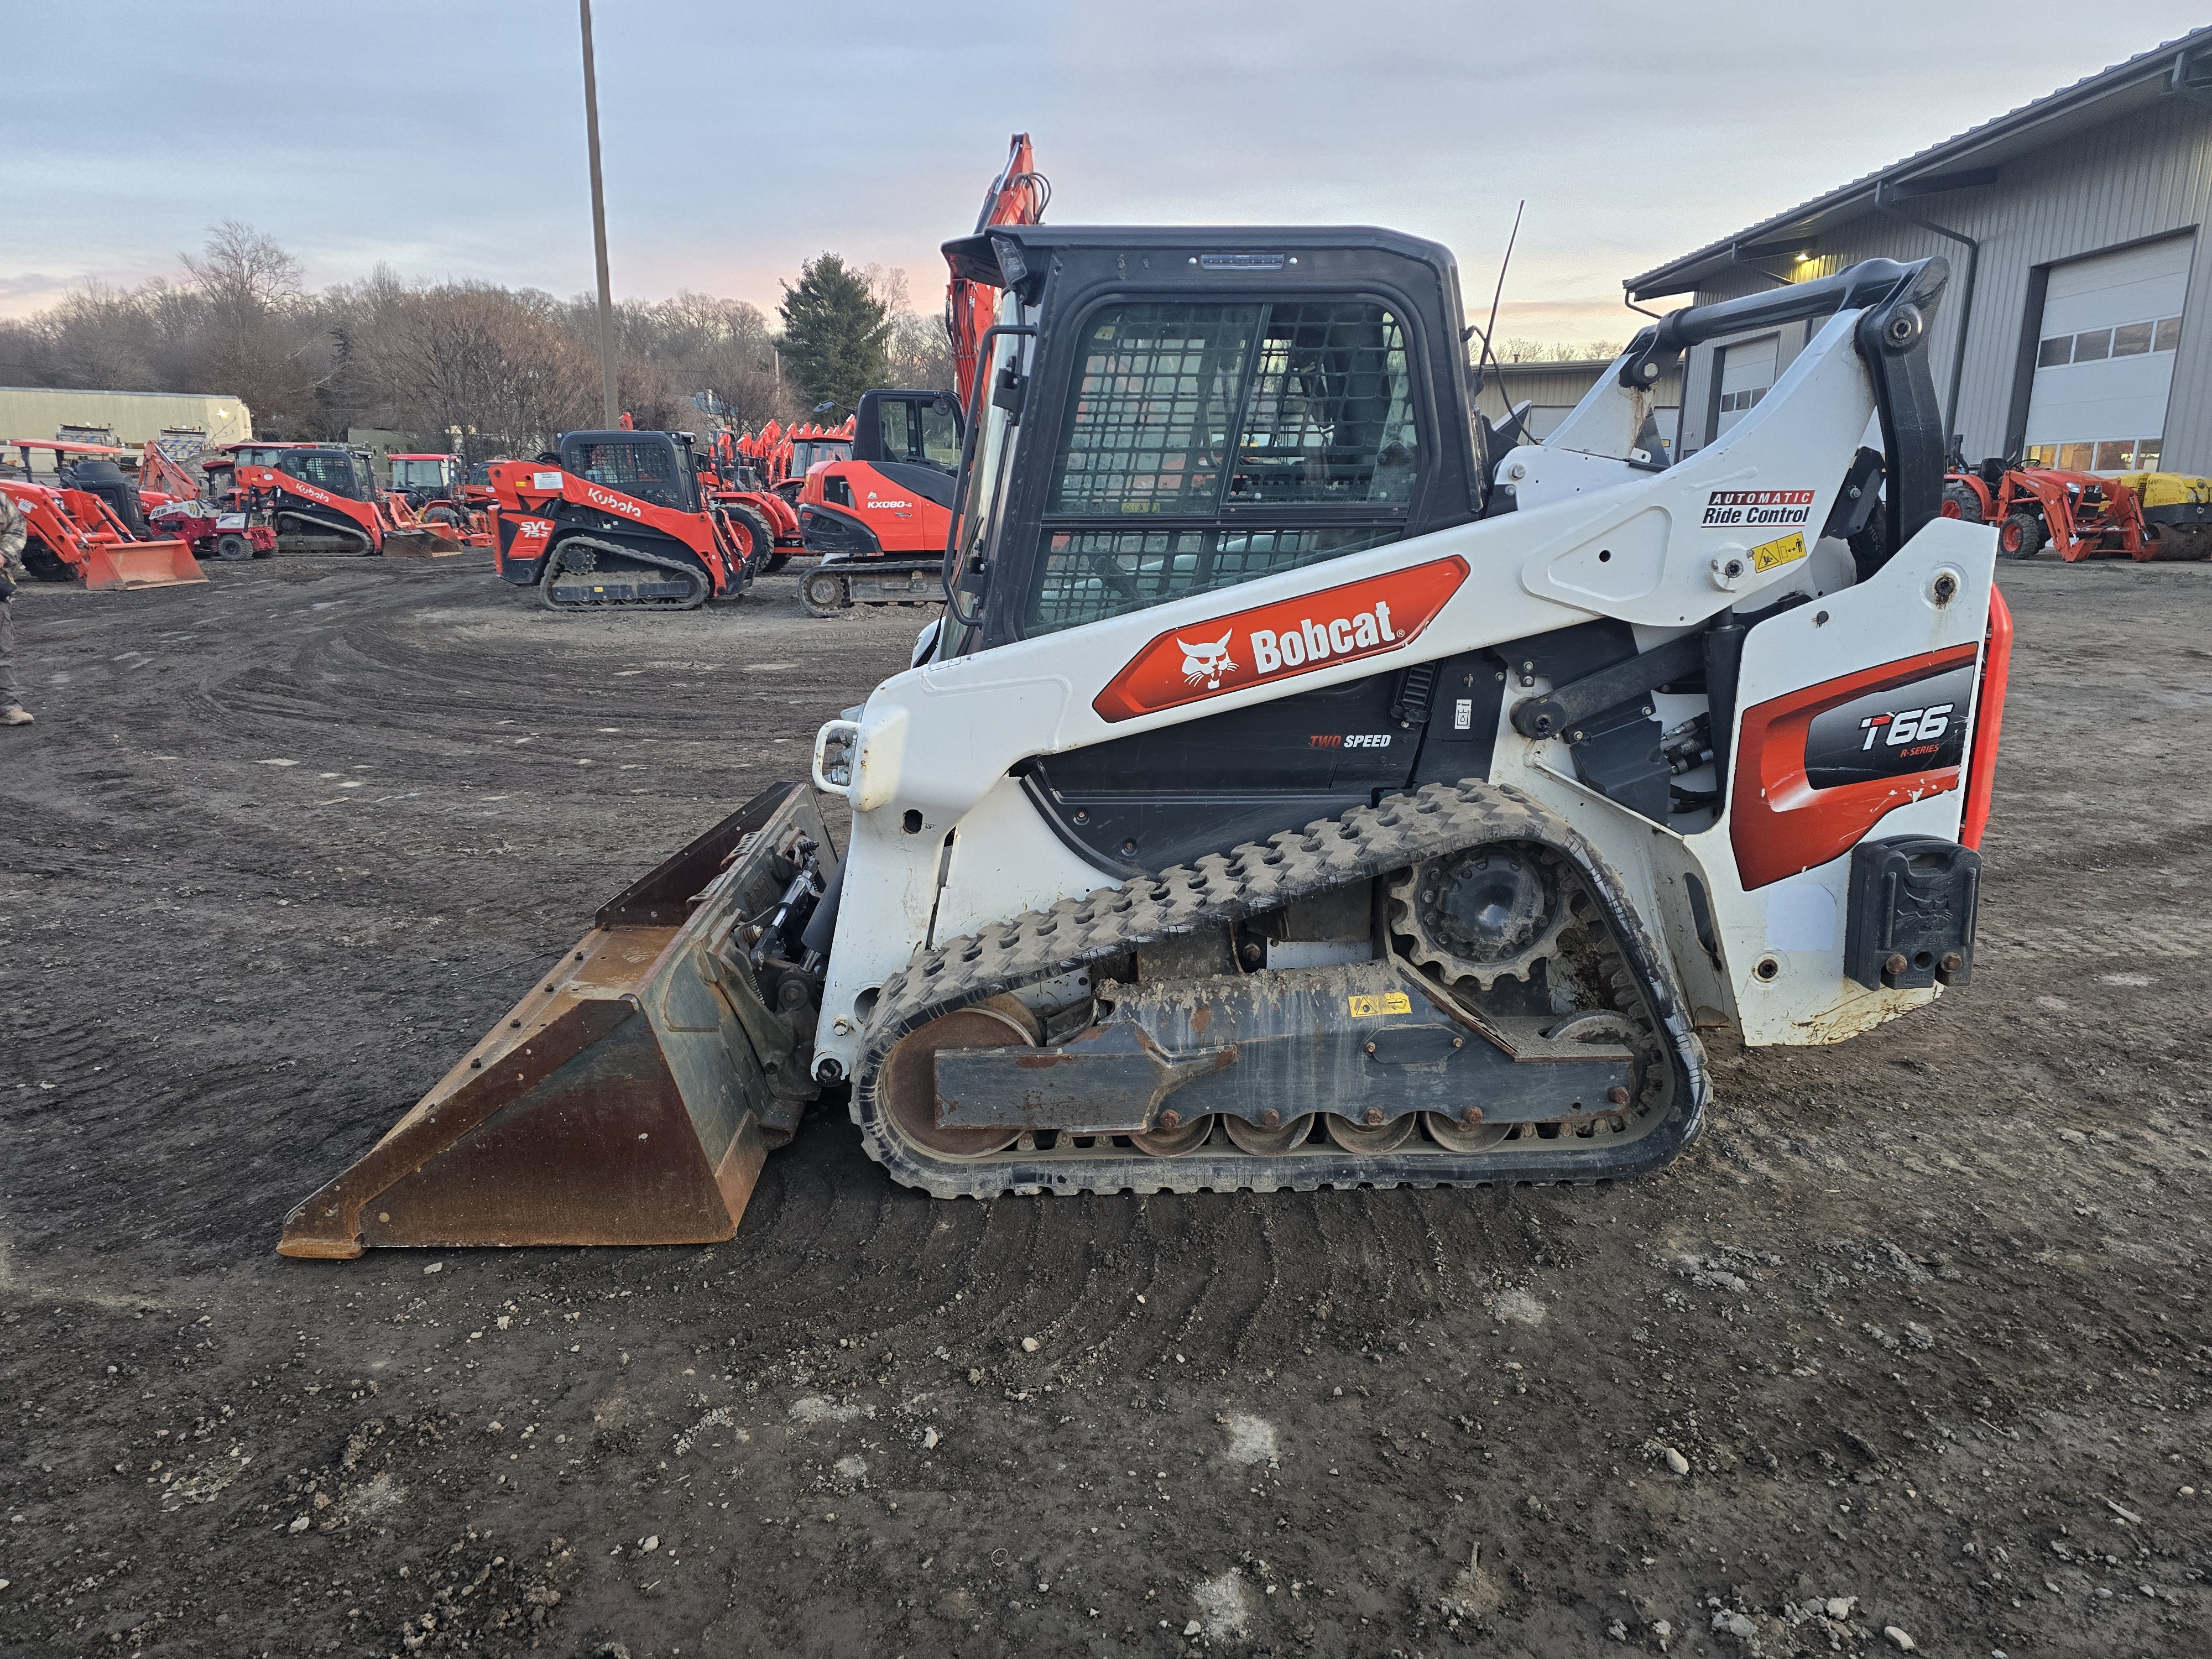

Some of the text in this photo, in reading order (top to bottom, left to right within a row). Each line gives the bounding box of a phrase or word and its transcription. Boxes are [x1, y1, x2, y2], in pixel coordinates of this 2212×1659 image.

[296, 483, 330, 503] Kubota
[1712, 492, 1811, 504] AUTOMATIC
[588, 487, 641, 518] Kubota
[1702, 506, 1811, 524] Ride Control
[520, 521, 552, 530] SVL
[1250, 601, 1396, 674] Bobcat
[1860, 704, 1954, 751] T66
[1310, 734, 1391, 748] TWO SPEED
[1900, 743, 1940, 758] R-SERIES
